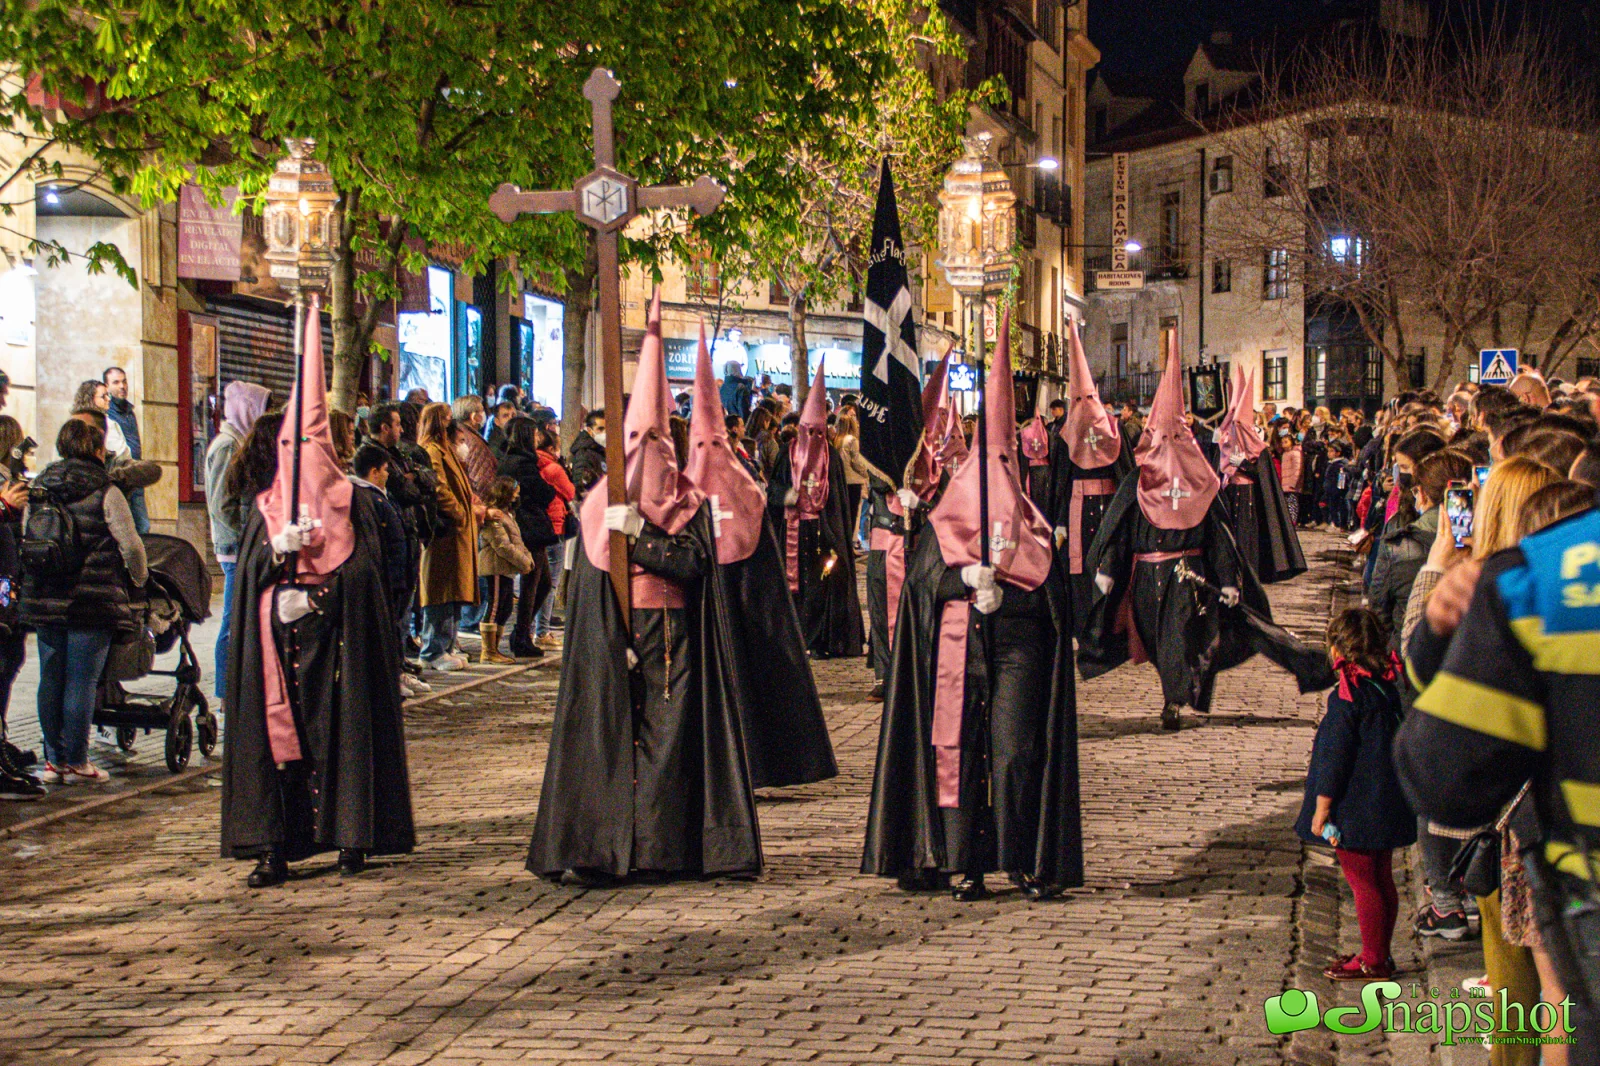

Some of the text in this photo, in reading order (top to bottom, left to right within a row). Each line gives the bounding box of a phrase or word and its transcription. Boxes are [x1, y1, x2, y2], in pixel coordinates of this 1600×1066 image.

[190, 240, 230, 252] DIGITAL
[181, 254, 194, 264] EN
[213, 257, 240, 267] ACTO
